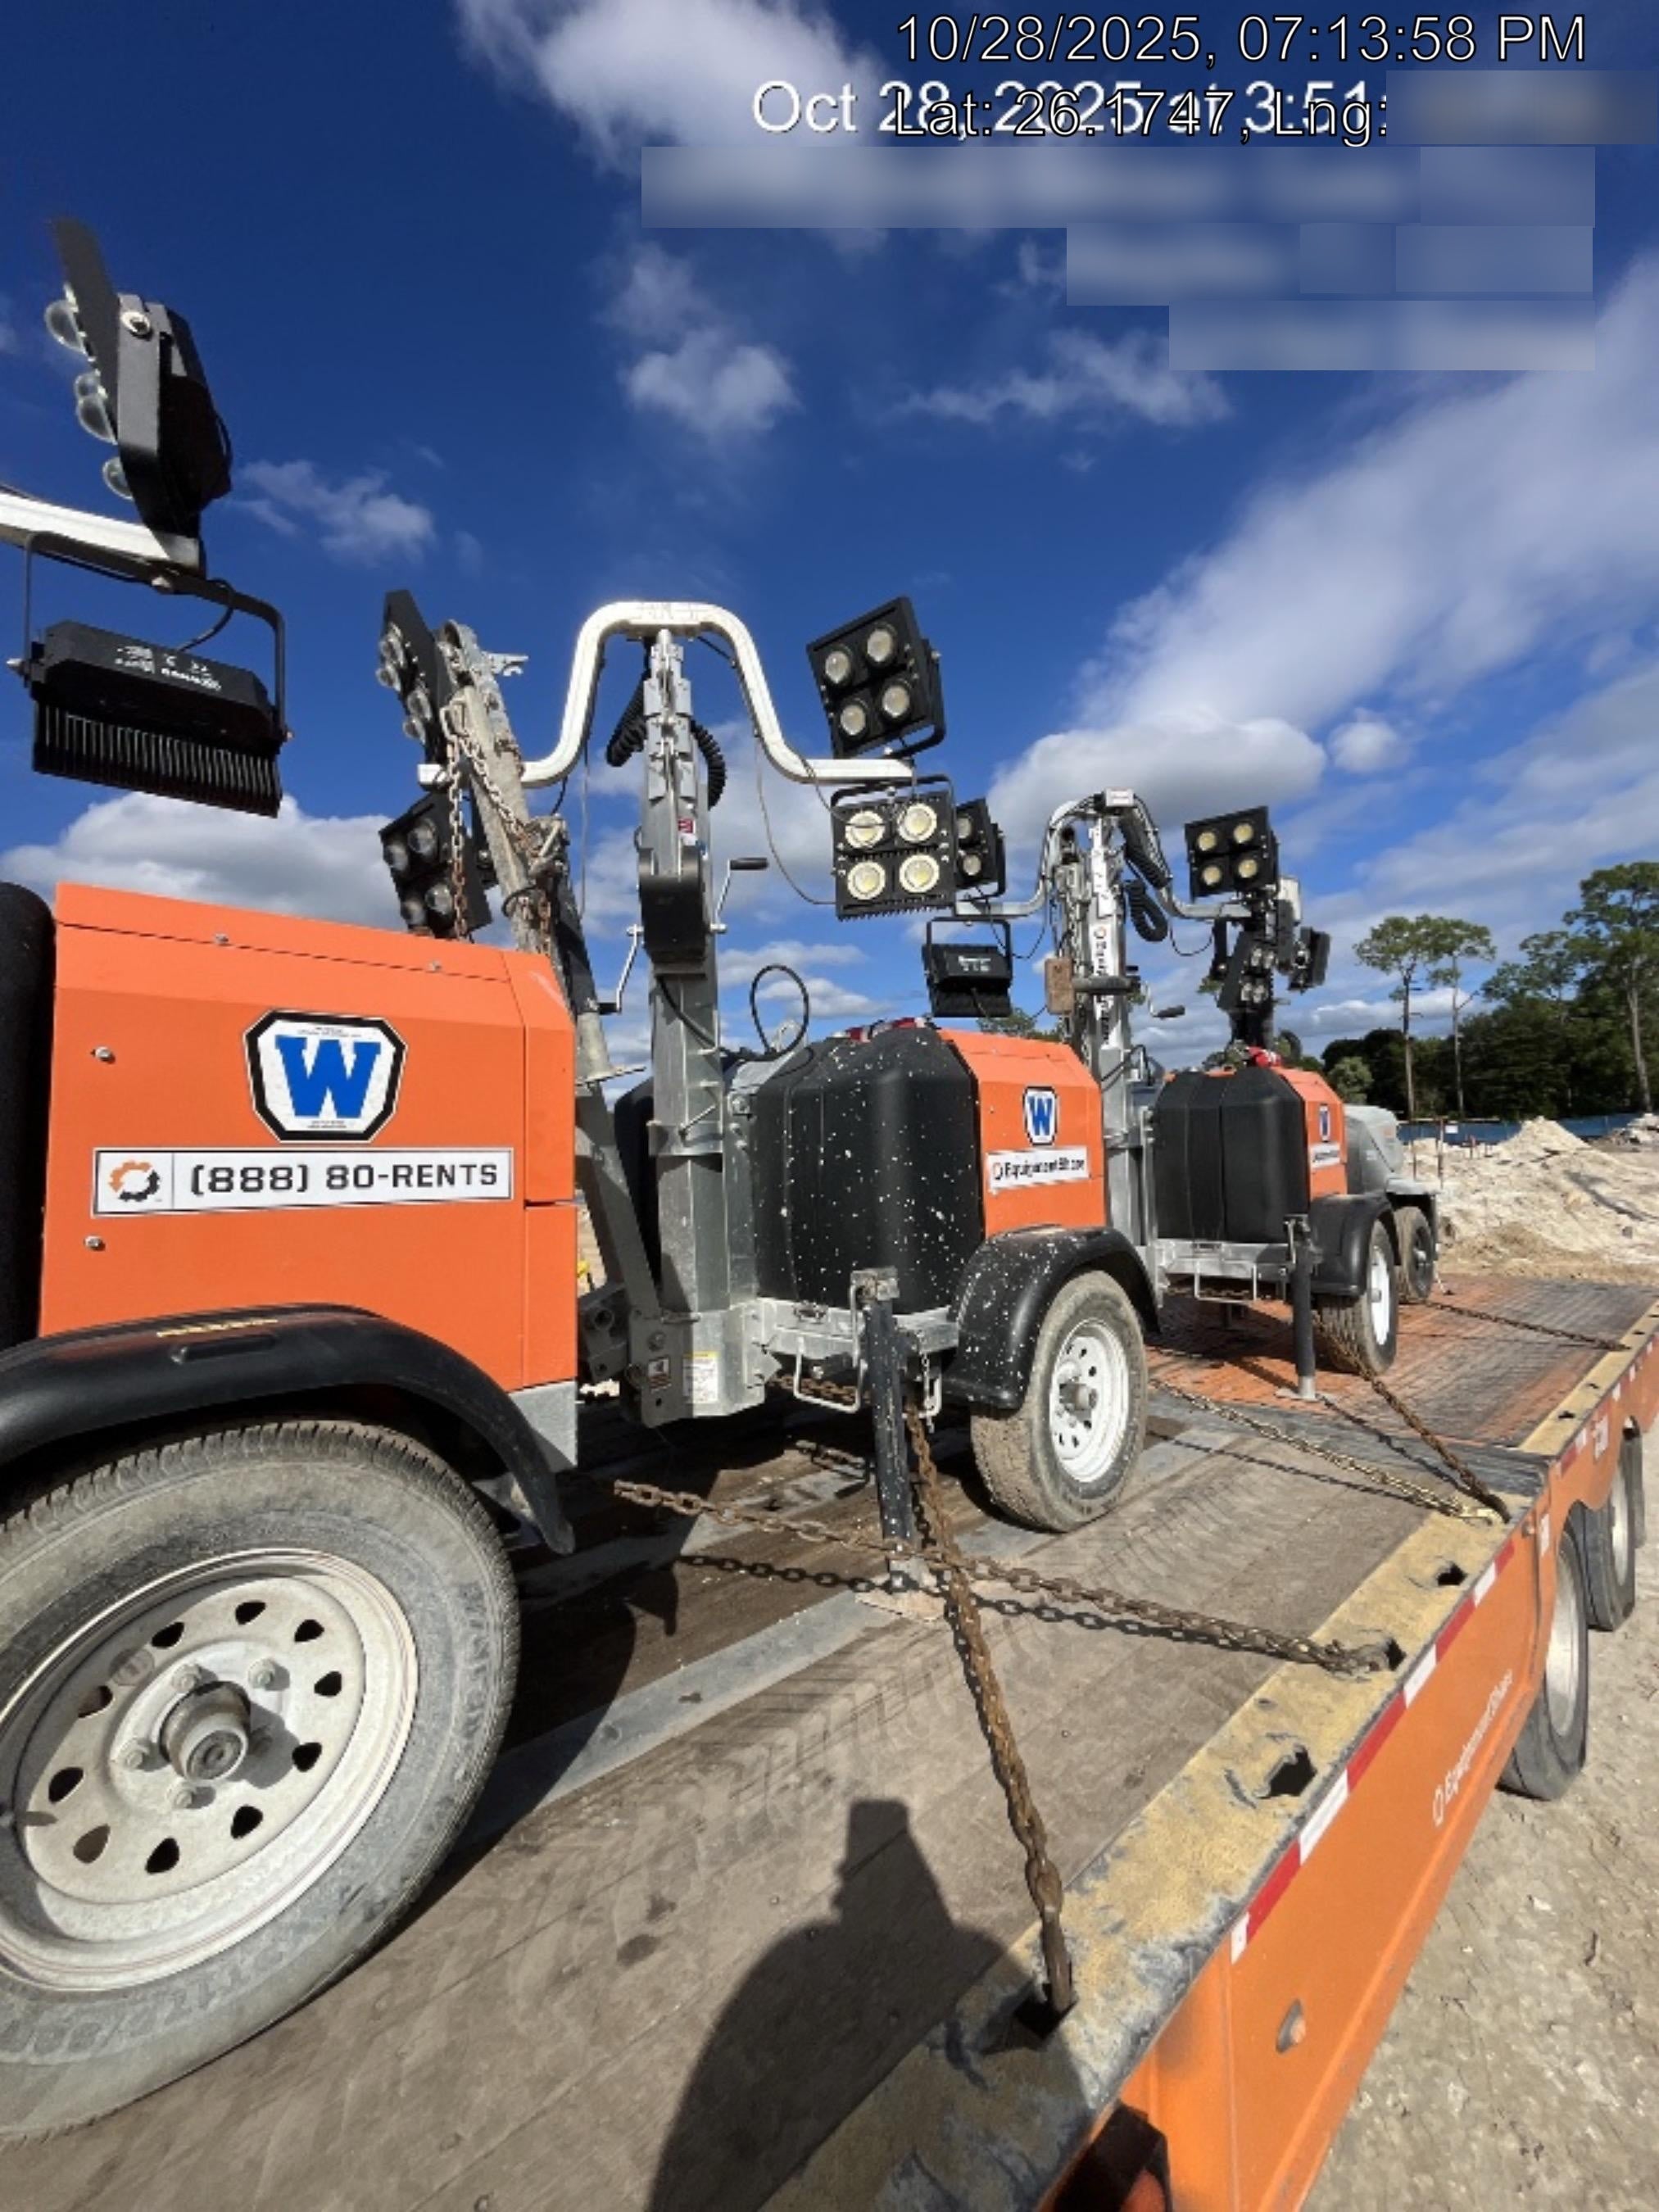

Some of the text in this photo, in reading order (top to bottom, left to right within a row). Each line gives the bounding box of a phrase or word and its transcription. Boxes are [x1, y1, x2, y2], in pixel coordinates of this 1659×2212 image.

[275, 1035, 381, 1118] W
[1027, 1096, 1053, 1136] W
[190, 1163, 498, 1196] (888) 80-RENTS
